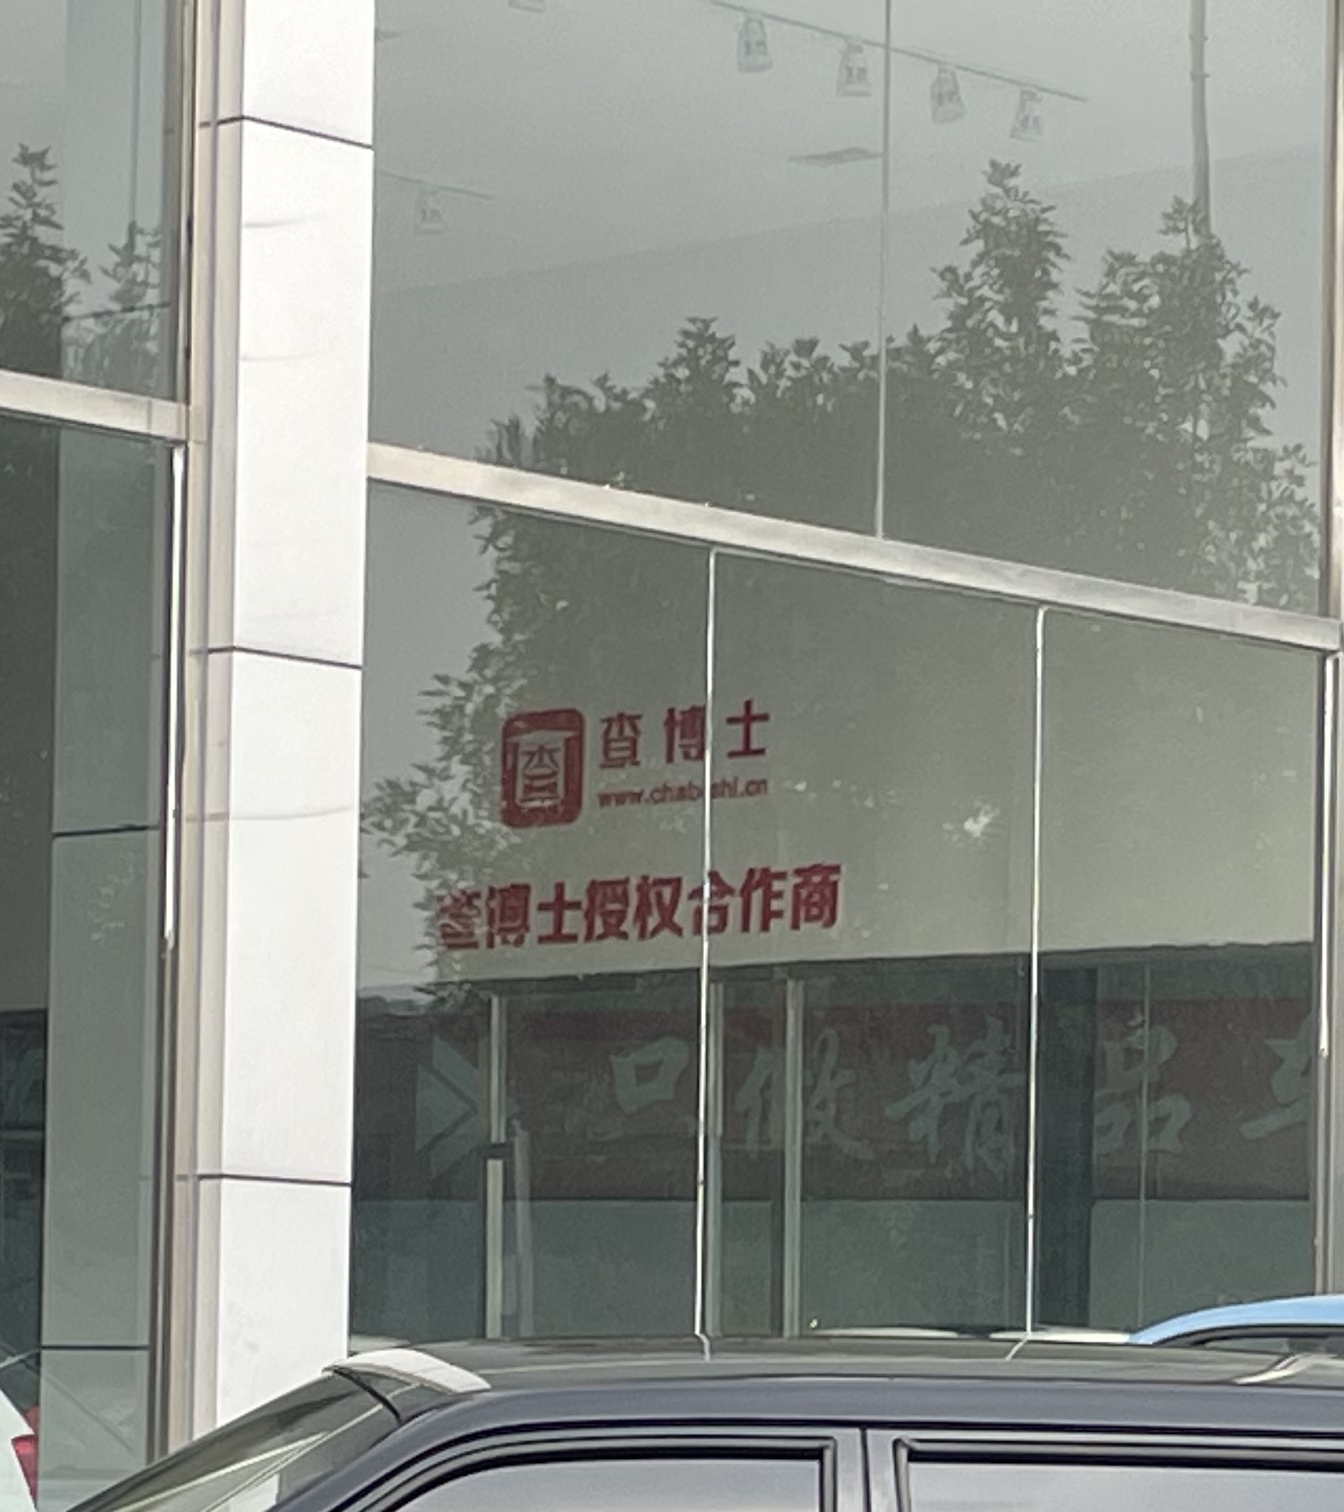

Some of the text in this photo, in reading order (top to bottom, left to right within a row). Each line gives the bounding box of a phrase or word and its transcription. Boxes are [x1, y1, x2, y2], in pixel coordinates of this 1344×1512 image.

[599, 699, 770, 769] 查博士
[598, 779, 769, 808] www.chabshi.cn
